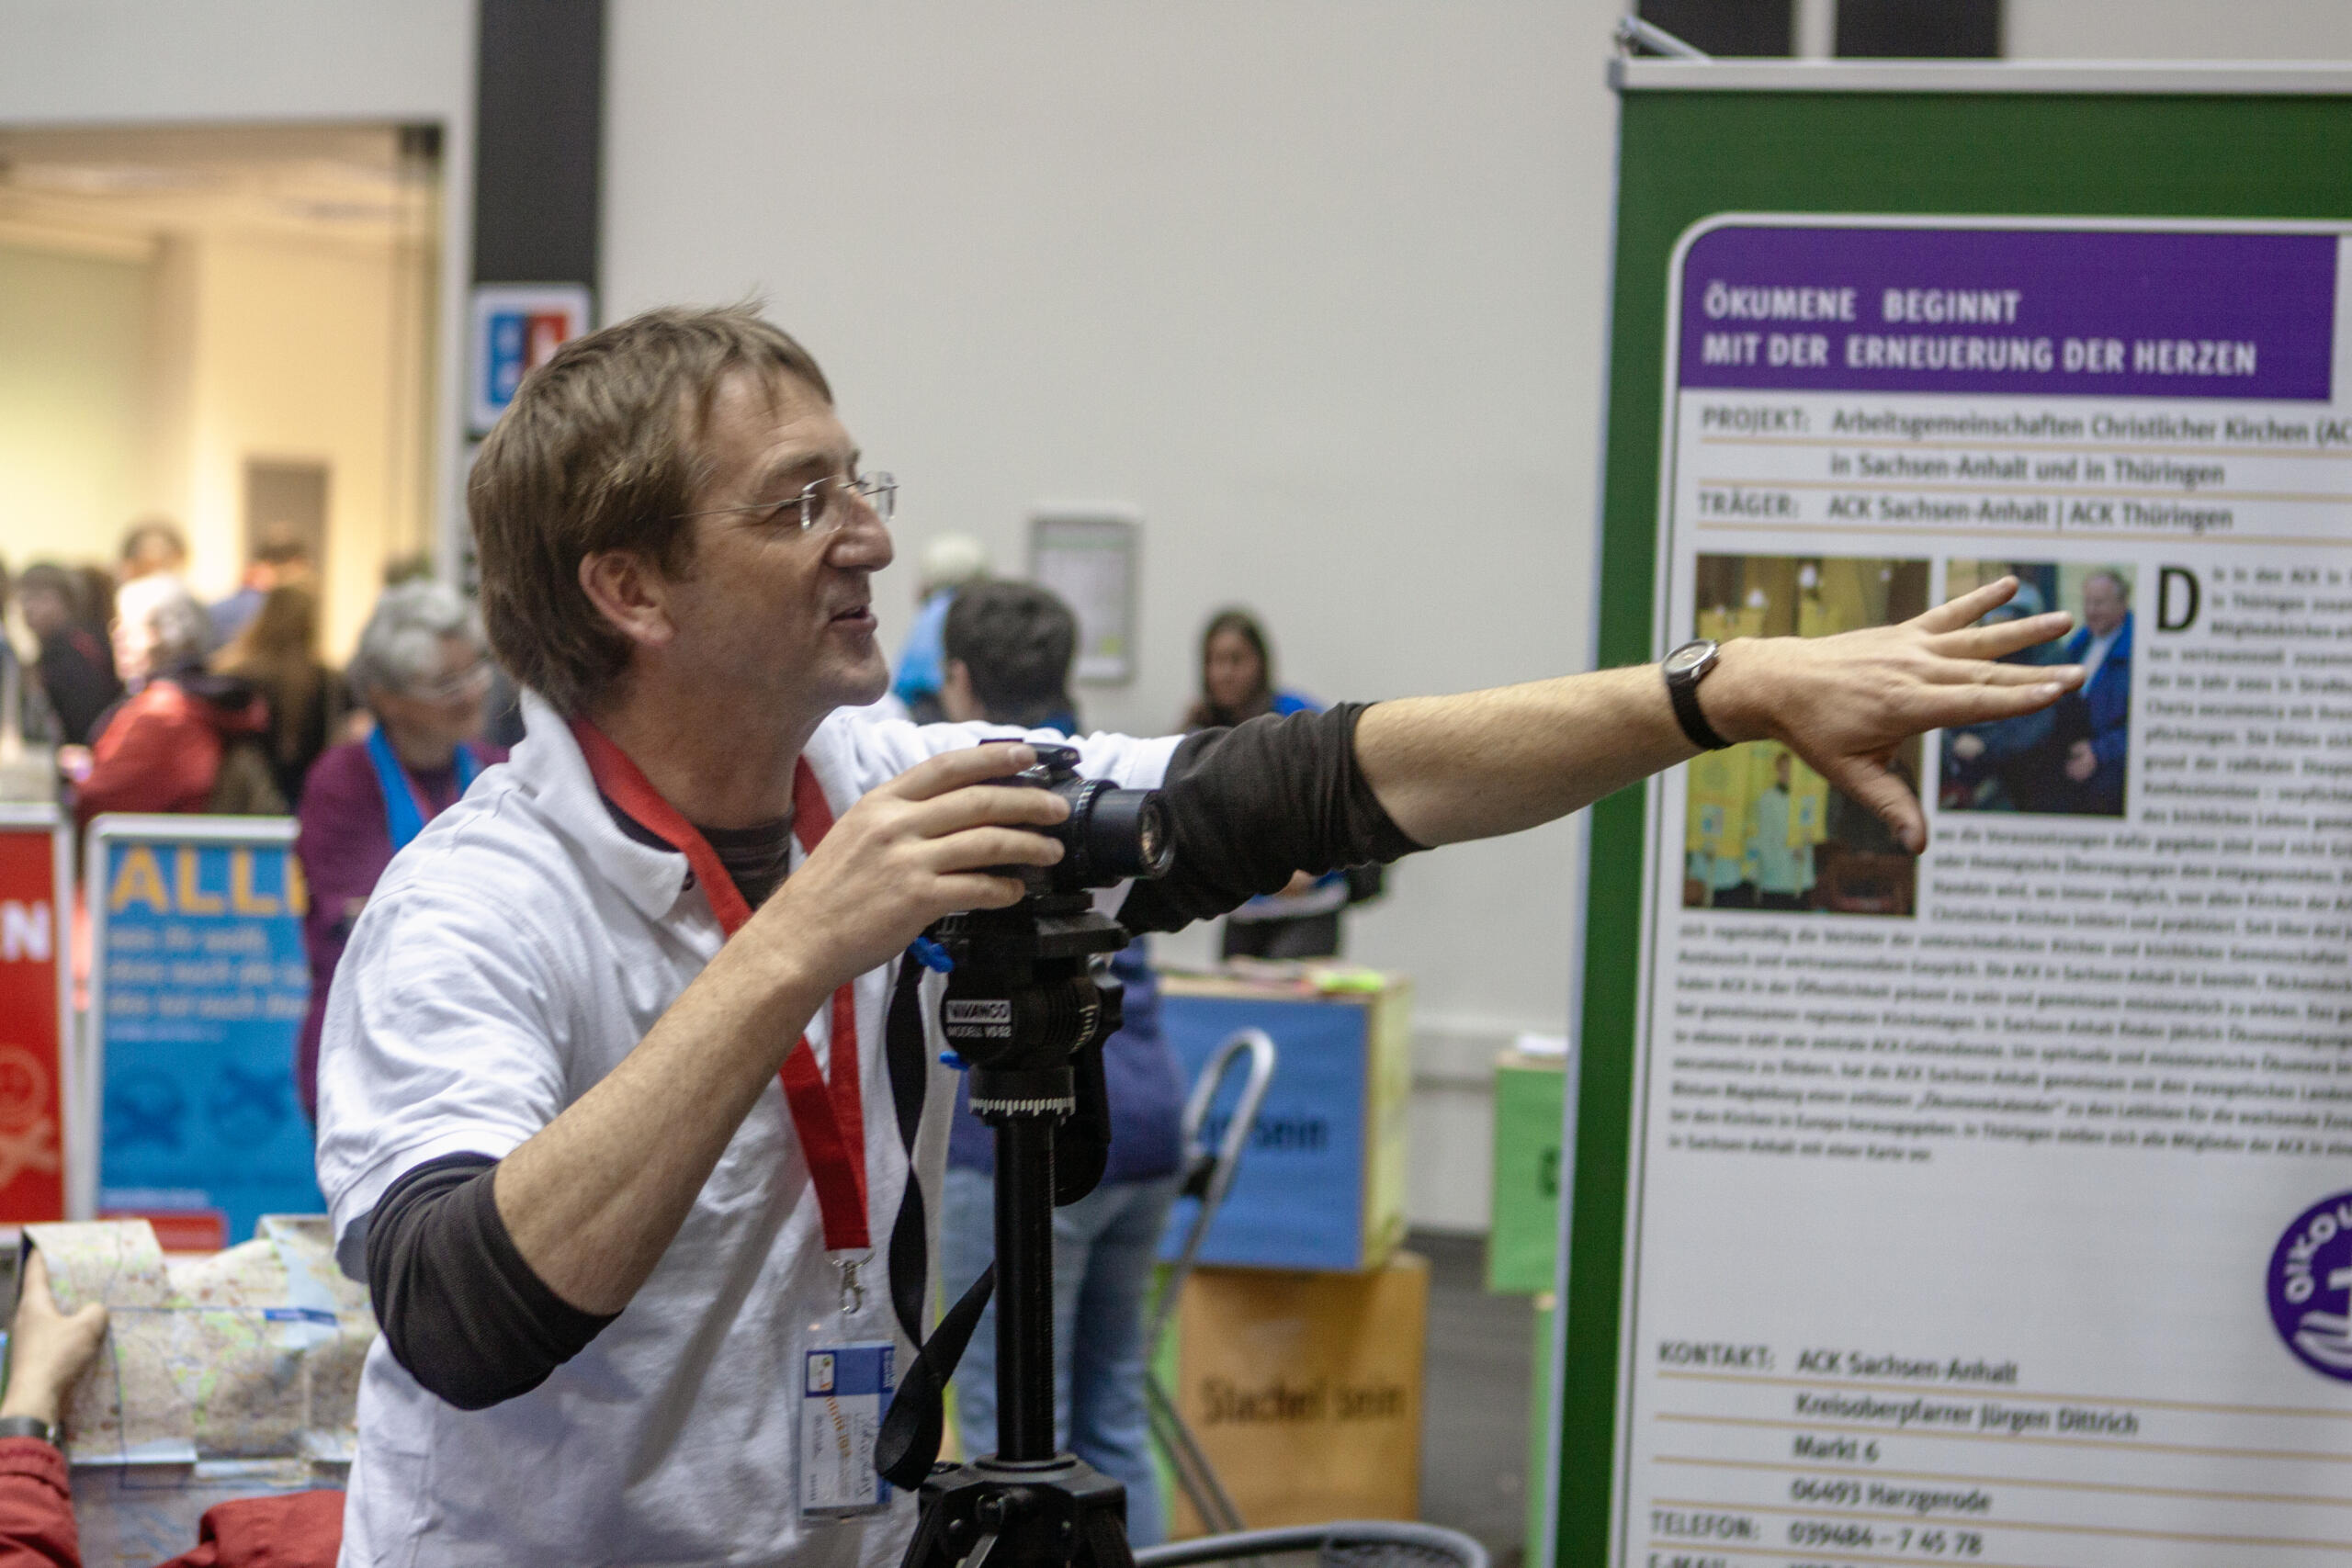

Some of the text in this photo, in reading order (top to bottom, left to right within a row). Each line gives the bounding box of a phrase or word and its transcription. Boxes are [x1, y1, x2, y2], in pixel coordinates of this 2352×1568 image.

[1703, 281, 2020, 322] ÖKUMENE BEGINNT
[1702, 333, 2256, 374] MIT DER ERNEUERUNG DER HERZEN
[1702, 406, 1811, 436] PROJEKT:
[1832, 410, 2084, 441] Arbeitsgemeinschaften
[2091, 412, 2219, 443] Christlicher
[2225, 416, 2310, 442] Kirchen
[1830, 453, 2225, 491] in Sachsen-Anhalt und in Thüringen
[1700, 491, 1800, 519] TRÄGER:
[1827, 497, 1871, 522] ACK
[1879, 499, 2050, 526] Sachsen-Anhalt
[2070, 504, 2115, 528] ACK
[2123, 505, 2233, 535] Thüringen
[2156, 567, 2201, 635] D
[1657, 1341, 2018, 1384] KONTAKT: ACK Sachsen-Anhalt
[1795, 1393, 2139, 1437] Kreisoberpfarrer Jürgen Dittrich
[1793, 1436, 1880, 1462] Markt 6
[1869, 1483, 1992, 1516] Harzgerode
[1651, 1511, 1759, 1540] TELEFON:
